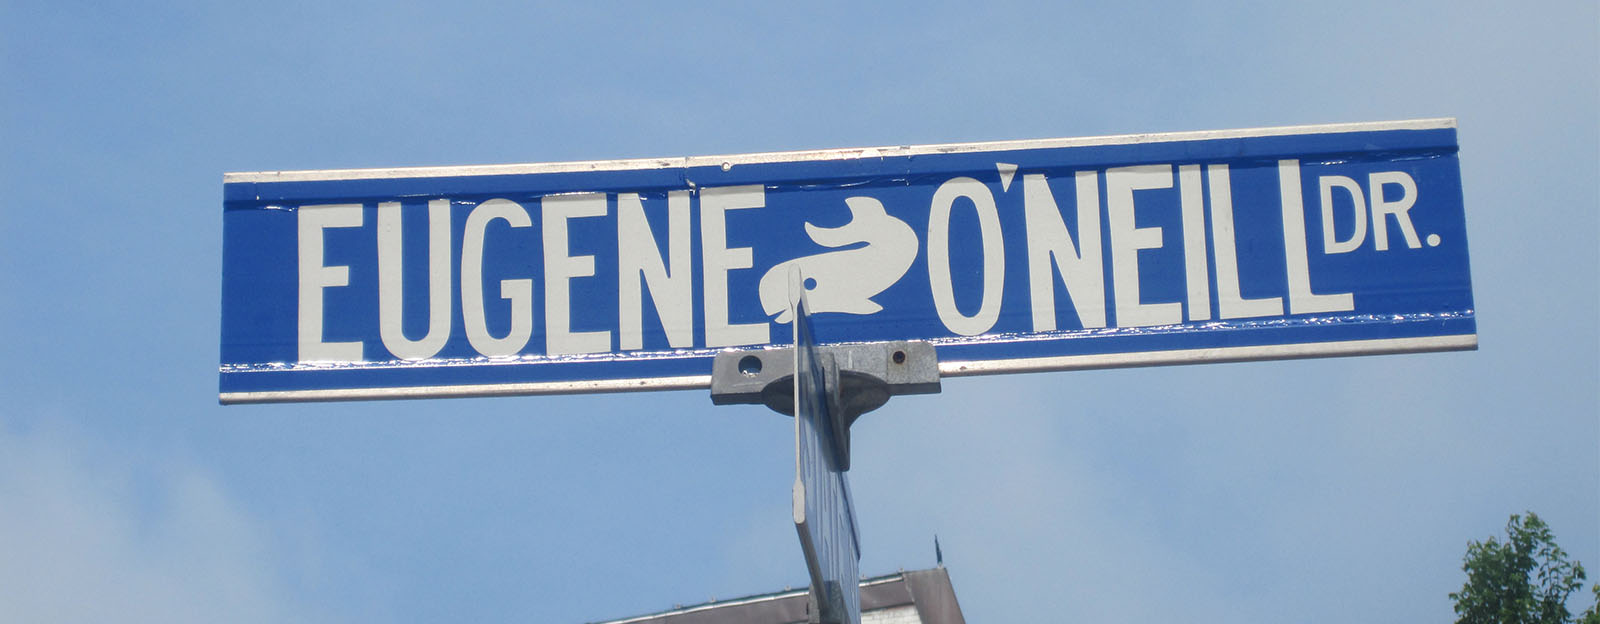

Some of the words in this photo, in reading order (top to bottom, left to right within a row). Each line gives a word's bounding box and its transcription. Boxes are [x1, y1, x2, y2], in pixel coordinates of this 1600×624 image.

[298, 185, 770, 362] EUGENE
[927, 159, 1355, 336] O'NEILL
[1319, 171, 1441, 255] DR.
